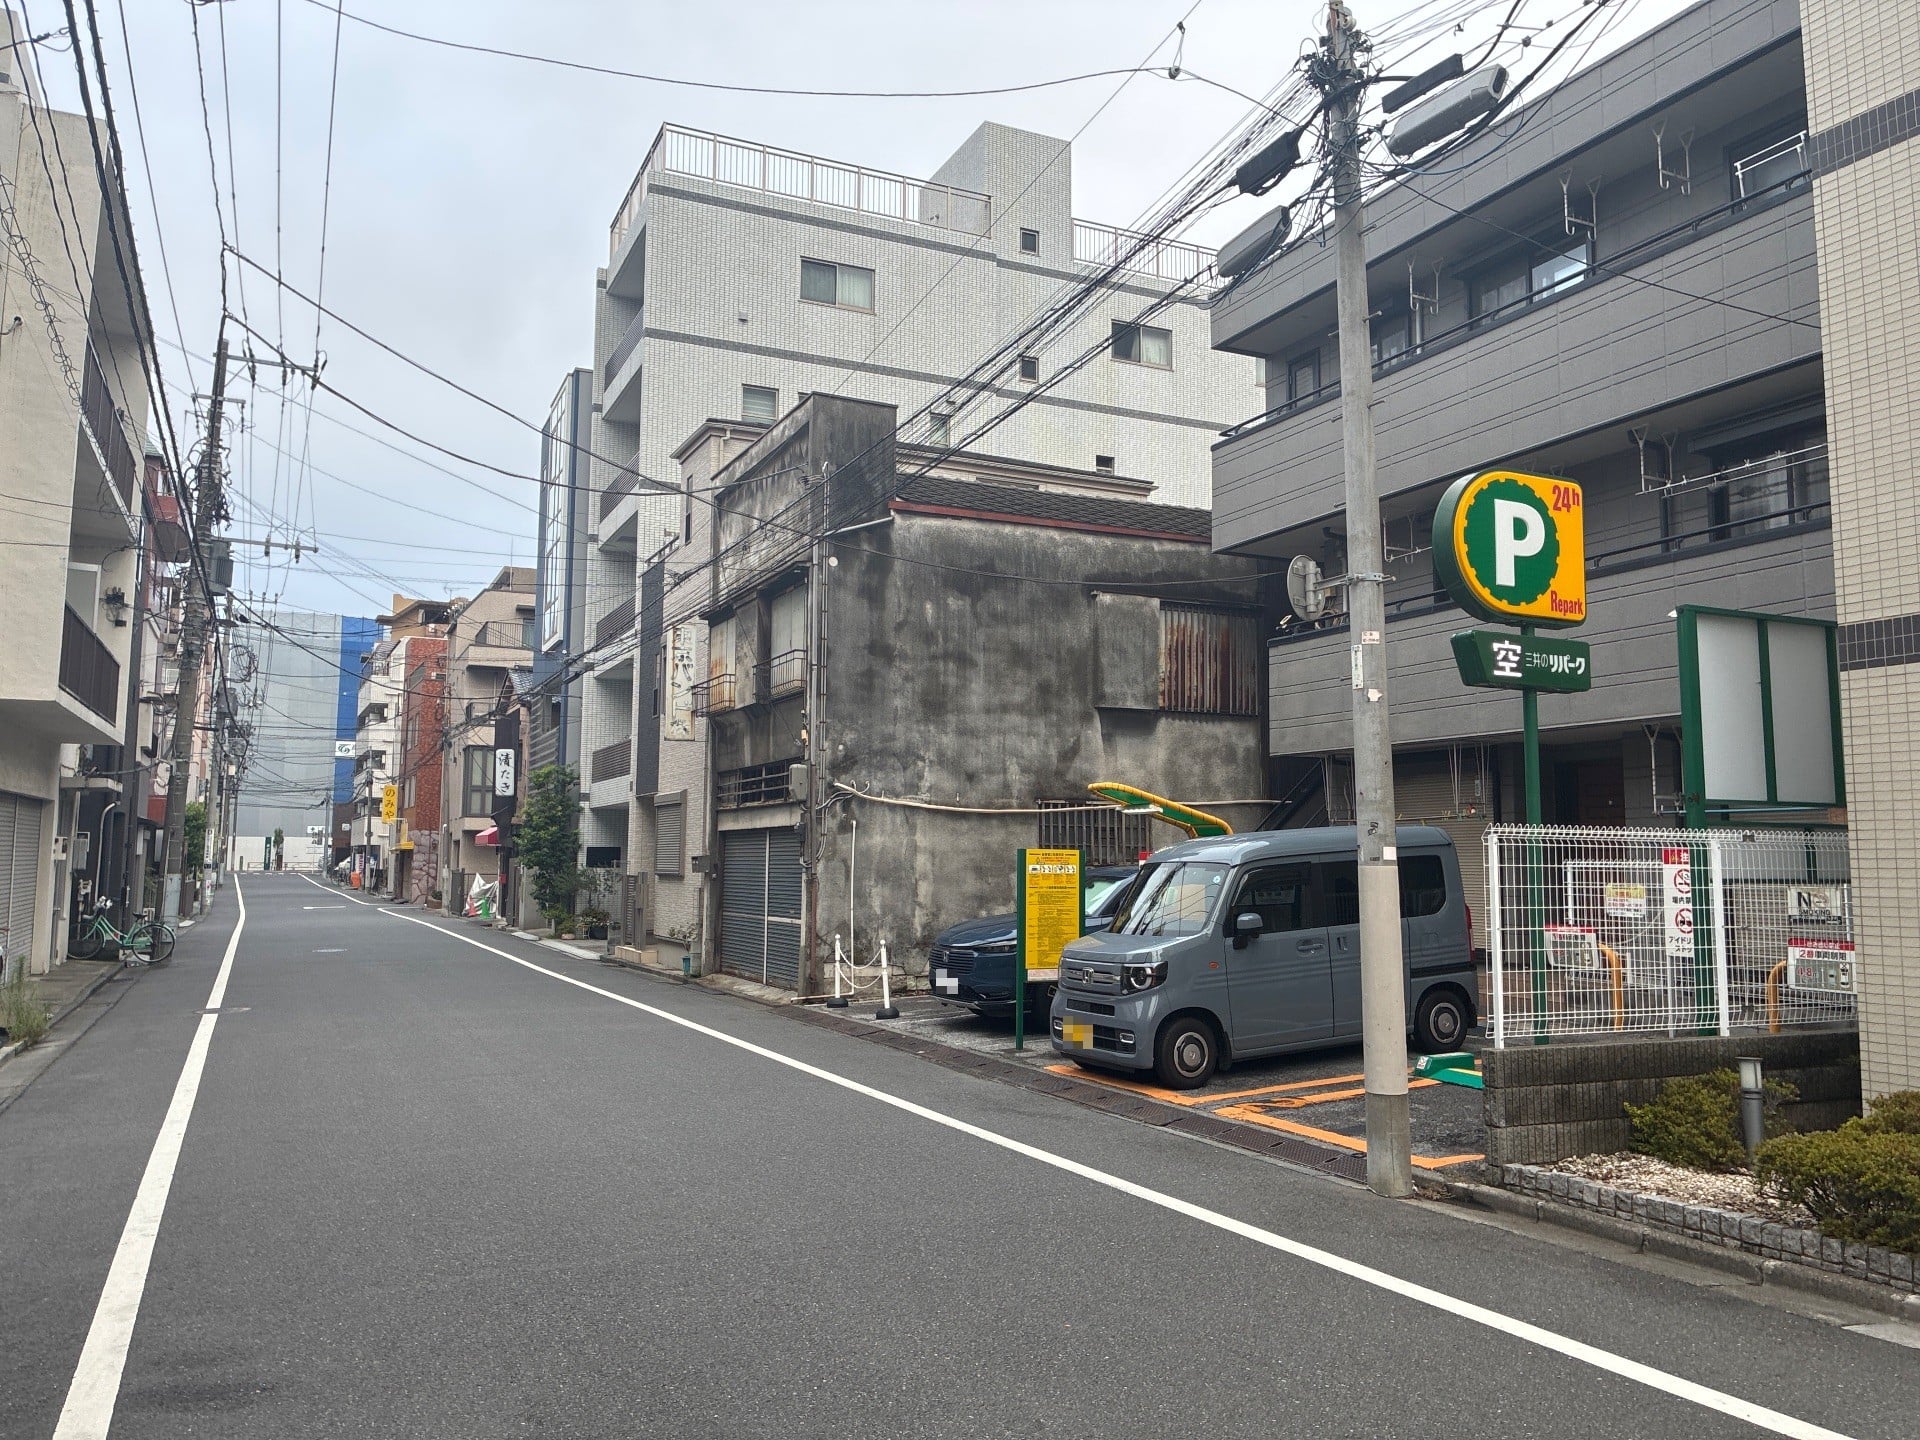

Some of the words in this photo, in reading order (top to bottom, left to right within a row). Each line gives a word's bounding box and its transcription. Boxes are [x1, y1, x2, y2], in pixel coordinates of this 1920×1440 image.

[1551, 484, 1581, 513] 24h
[1493, 499, 1546, 587] P
[1550, 590, 1584, 616] Repark
[1492, 640, 1523, 678] 空
[1525, 652, 1586, 675] 三井のリパーク
[385, 788, 396, 819] のみや
